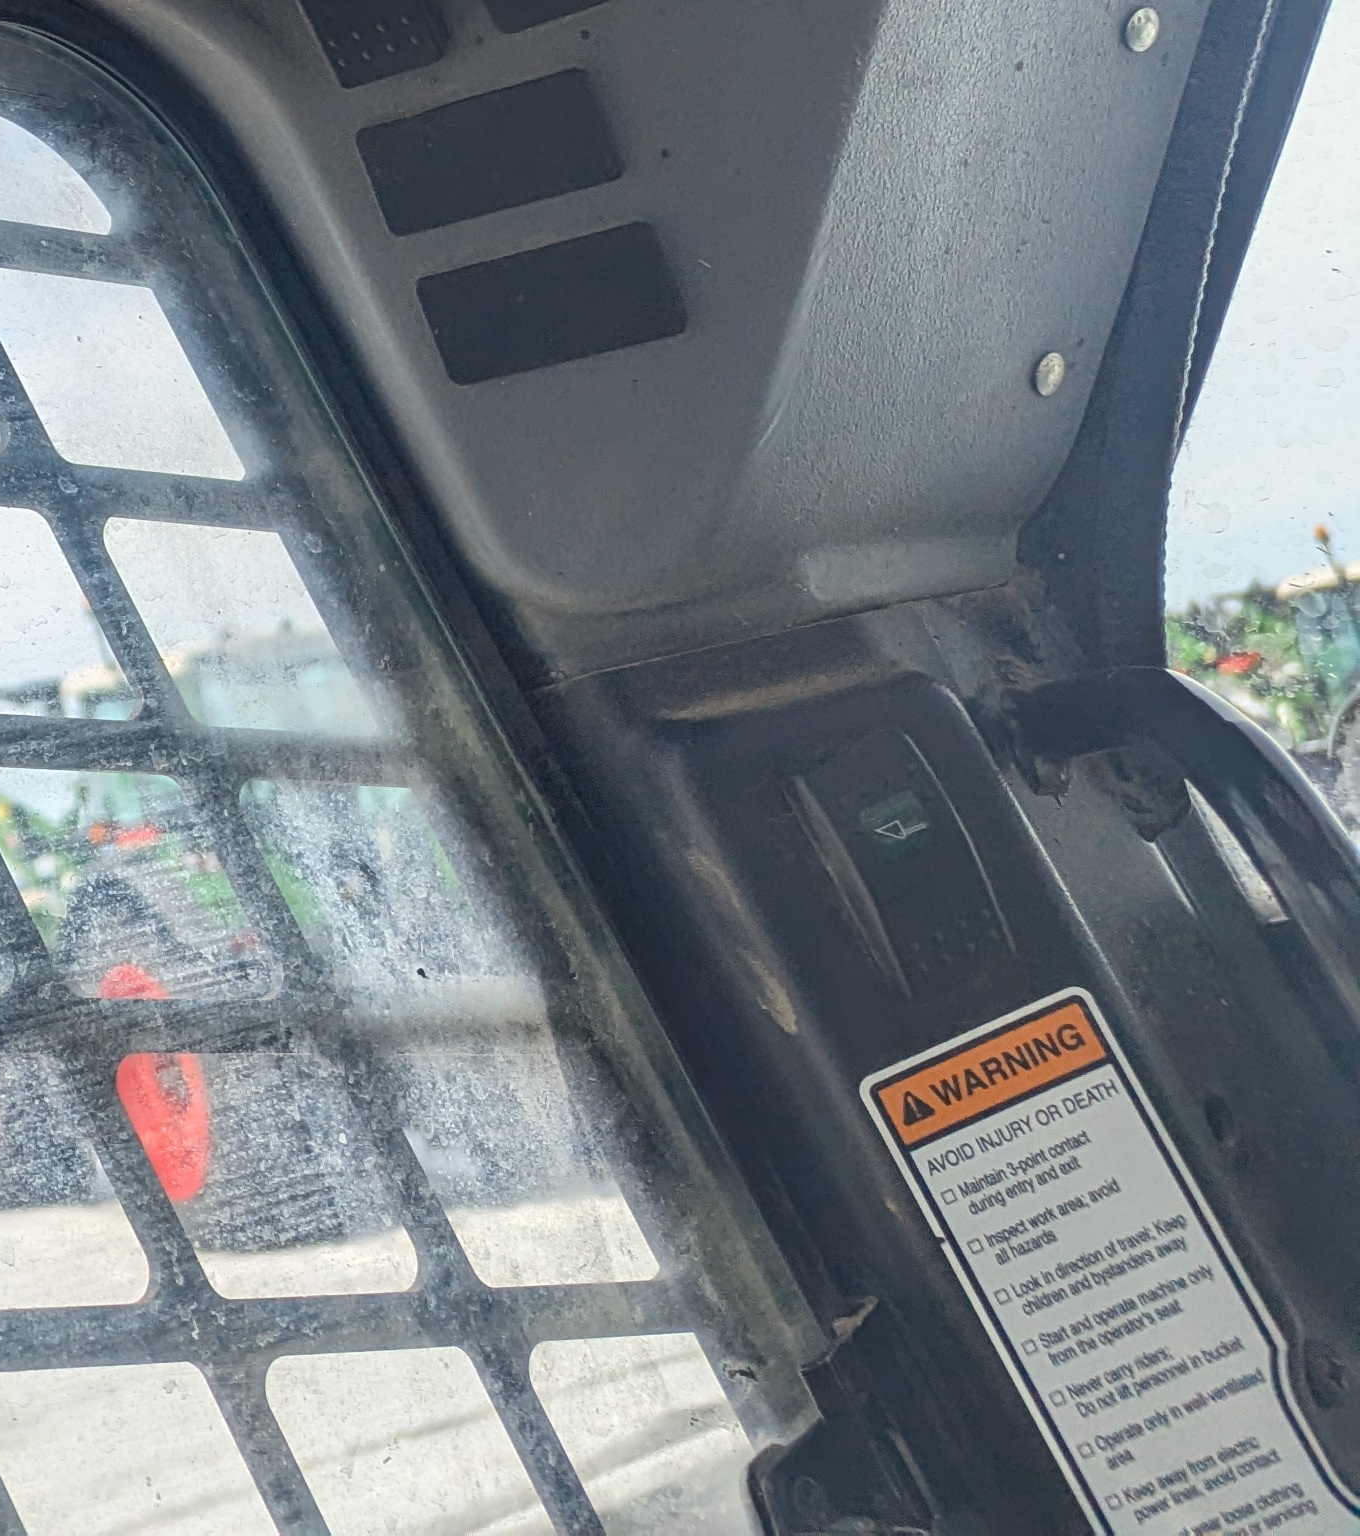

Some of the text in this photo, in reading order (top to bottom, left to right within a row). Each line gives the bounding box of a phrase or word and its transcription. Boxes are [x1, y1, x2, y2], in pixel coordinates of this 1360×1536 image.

[928, 1023, 1086, 1106] WARNING
[926, 1078, 1119, 1177] AVOID INJURY OR DEATH
[956, 1129, 1092, 1198] Maintain 3-point contact
[968, 1155, 1082, 1215] during entry and exit
[983, 1219, 1029, 1248] Inspect
[1026, 1207, 1058, 1229] work
[1087, 1177, 1121, 1203] avoid
[994, 1229, 1058, 1265] all hazards
[1009, 1275, 1043, 1298] Look
[1039, 1270, 1056, 1285] in
[1054, 1249, 1106, 1280] direction
[1103, 1240, 1118, 1258] of
[1151, 1214, 1188, 1236] Keep
[1021, 1236, 1187, 1316] children and bystanders away
[1038, 1265, 1214, 1349] Start and operate machine only
[1047, 1298, 1184, 1367] from the operator's seat
[1065, 1375, 1104, 1400] Never
[1103, 1363, 1135, 1384] carry
[1074, 1335, 1245, 1419] Do not lift personnel in bucket
[1094, 1422, 1145, 1451] Operate
[1143, 1411, 1170, 1431] only
[1168, 1405, 1184, 1419] in
[1107, 1449, 1135, 1470] area
[1121, 1481, 1156, 1504] Keep
[1156, 1468, 1188, 1489] away
[1185, 1455, 1217, 1476] from
[1133, 1497, 1170, 1524] power
[1235, 1448, 1281, 1477] contact
